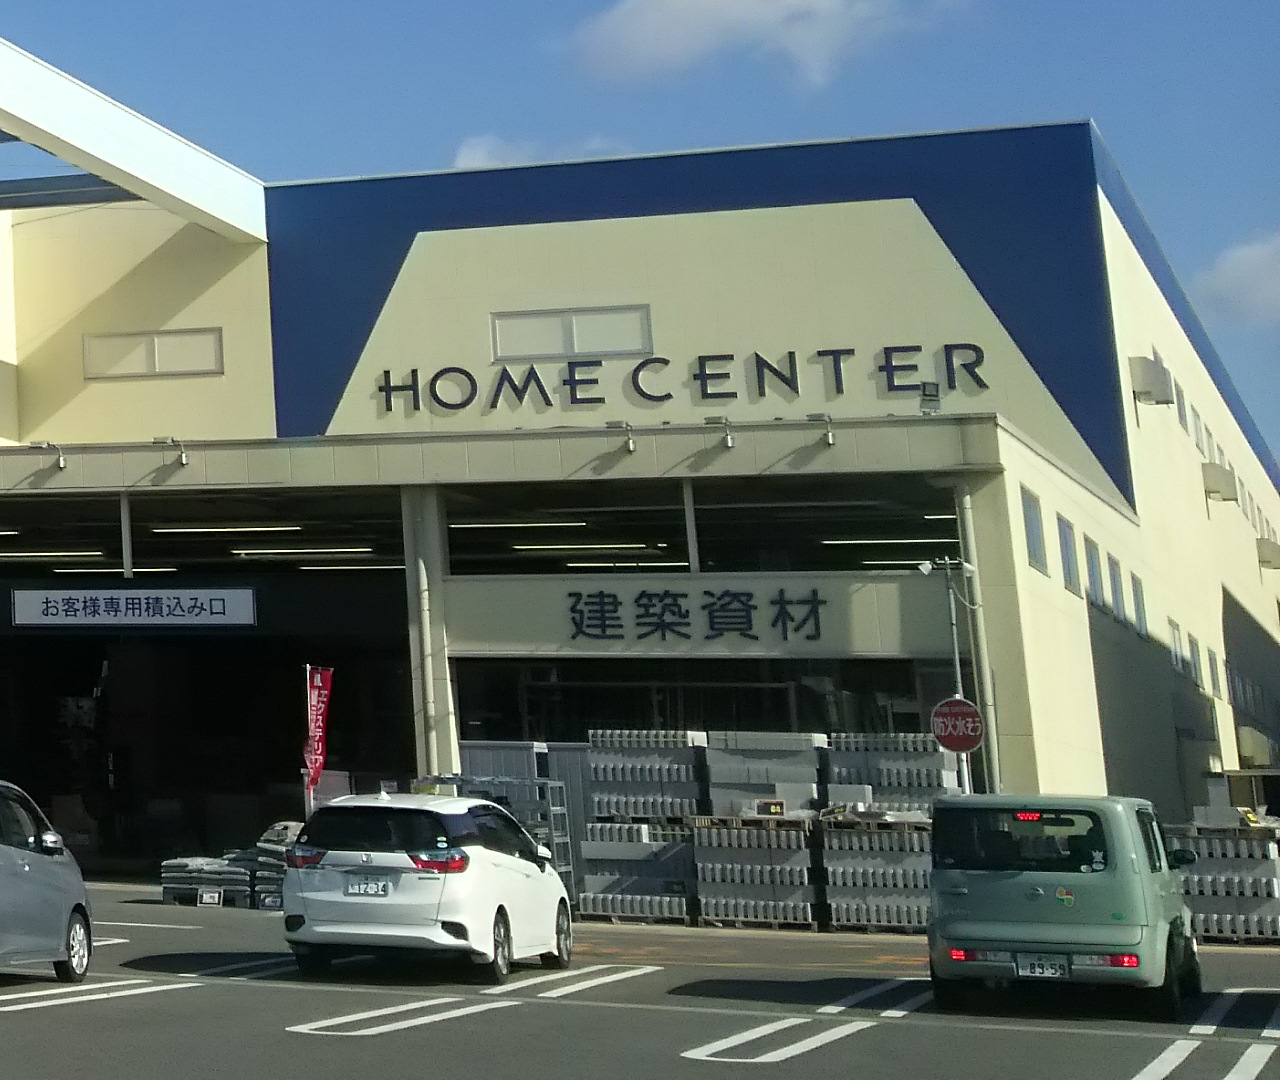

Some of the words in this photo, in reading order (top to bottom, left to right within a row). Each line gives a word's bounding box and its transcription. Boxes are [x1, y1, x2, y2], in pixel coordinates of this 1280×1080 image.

[41, 596, 227, 618] お客様専用積込み口
[568, 589, 828, 641] 建築資材
[934, 716, 982, 736] 防火水そう
